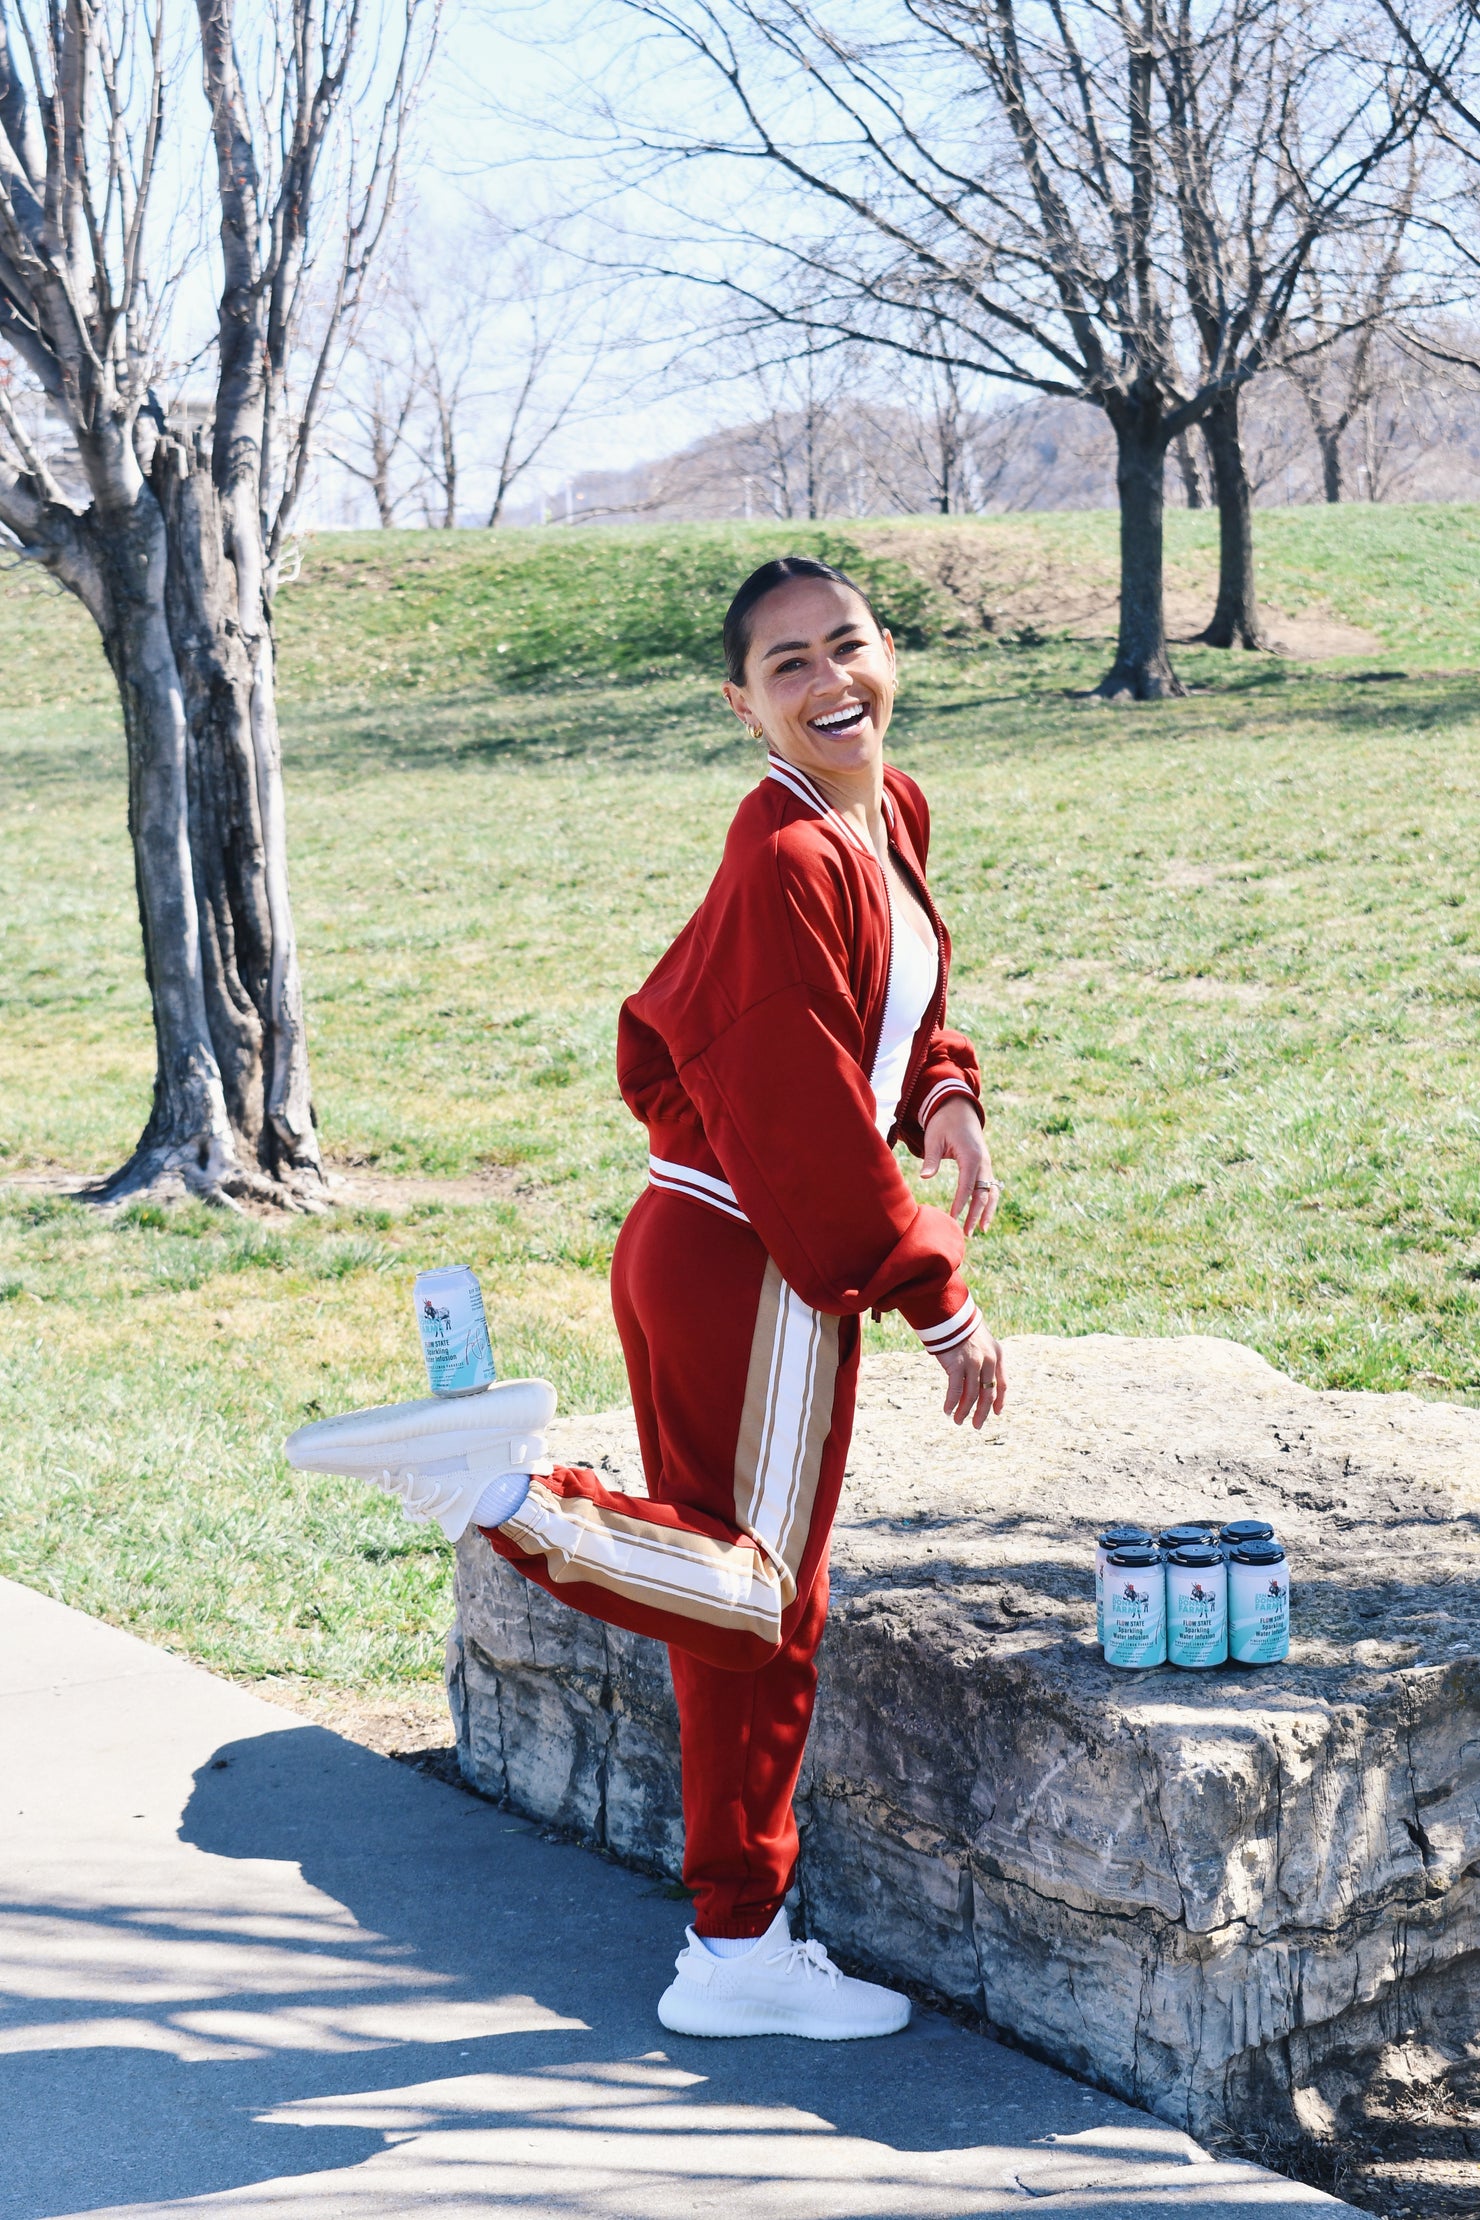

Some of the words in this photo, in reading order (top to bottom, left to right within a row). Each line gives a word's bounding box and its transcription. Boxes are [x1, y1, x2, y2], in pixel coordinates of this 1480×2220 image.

[435, 1339, 450, 1347] STATE
[1255, 1603, 1281, 1611] FARM
[1262, 1621, 1284, 1631] Sparkling
[1118, 1627, 1143, 1635] Sparkling
[1185, 1626, 1210, 1635] Sparkling
